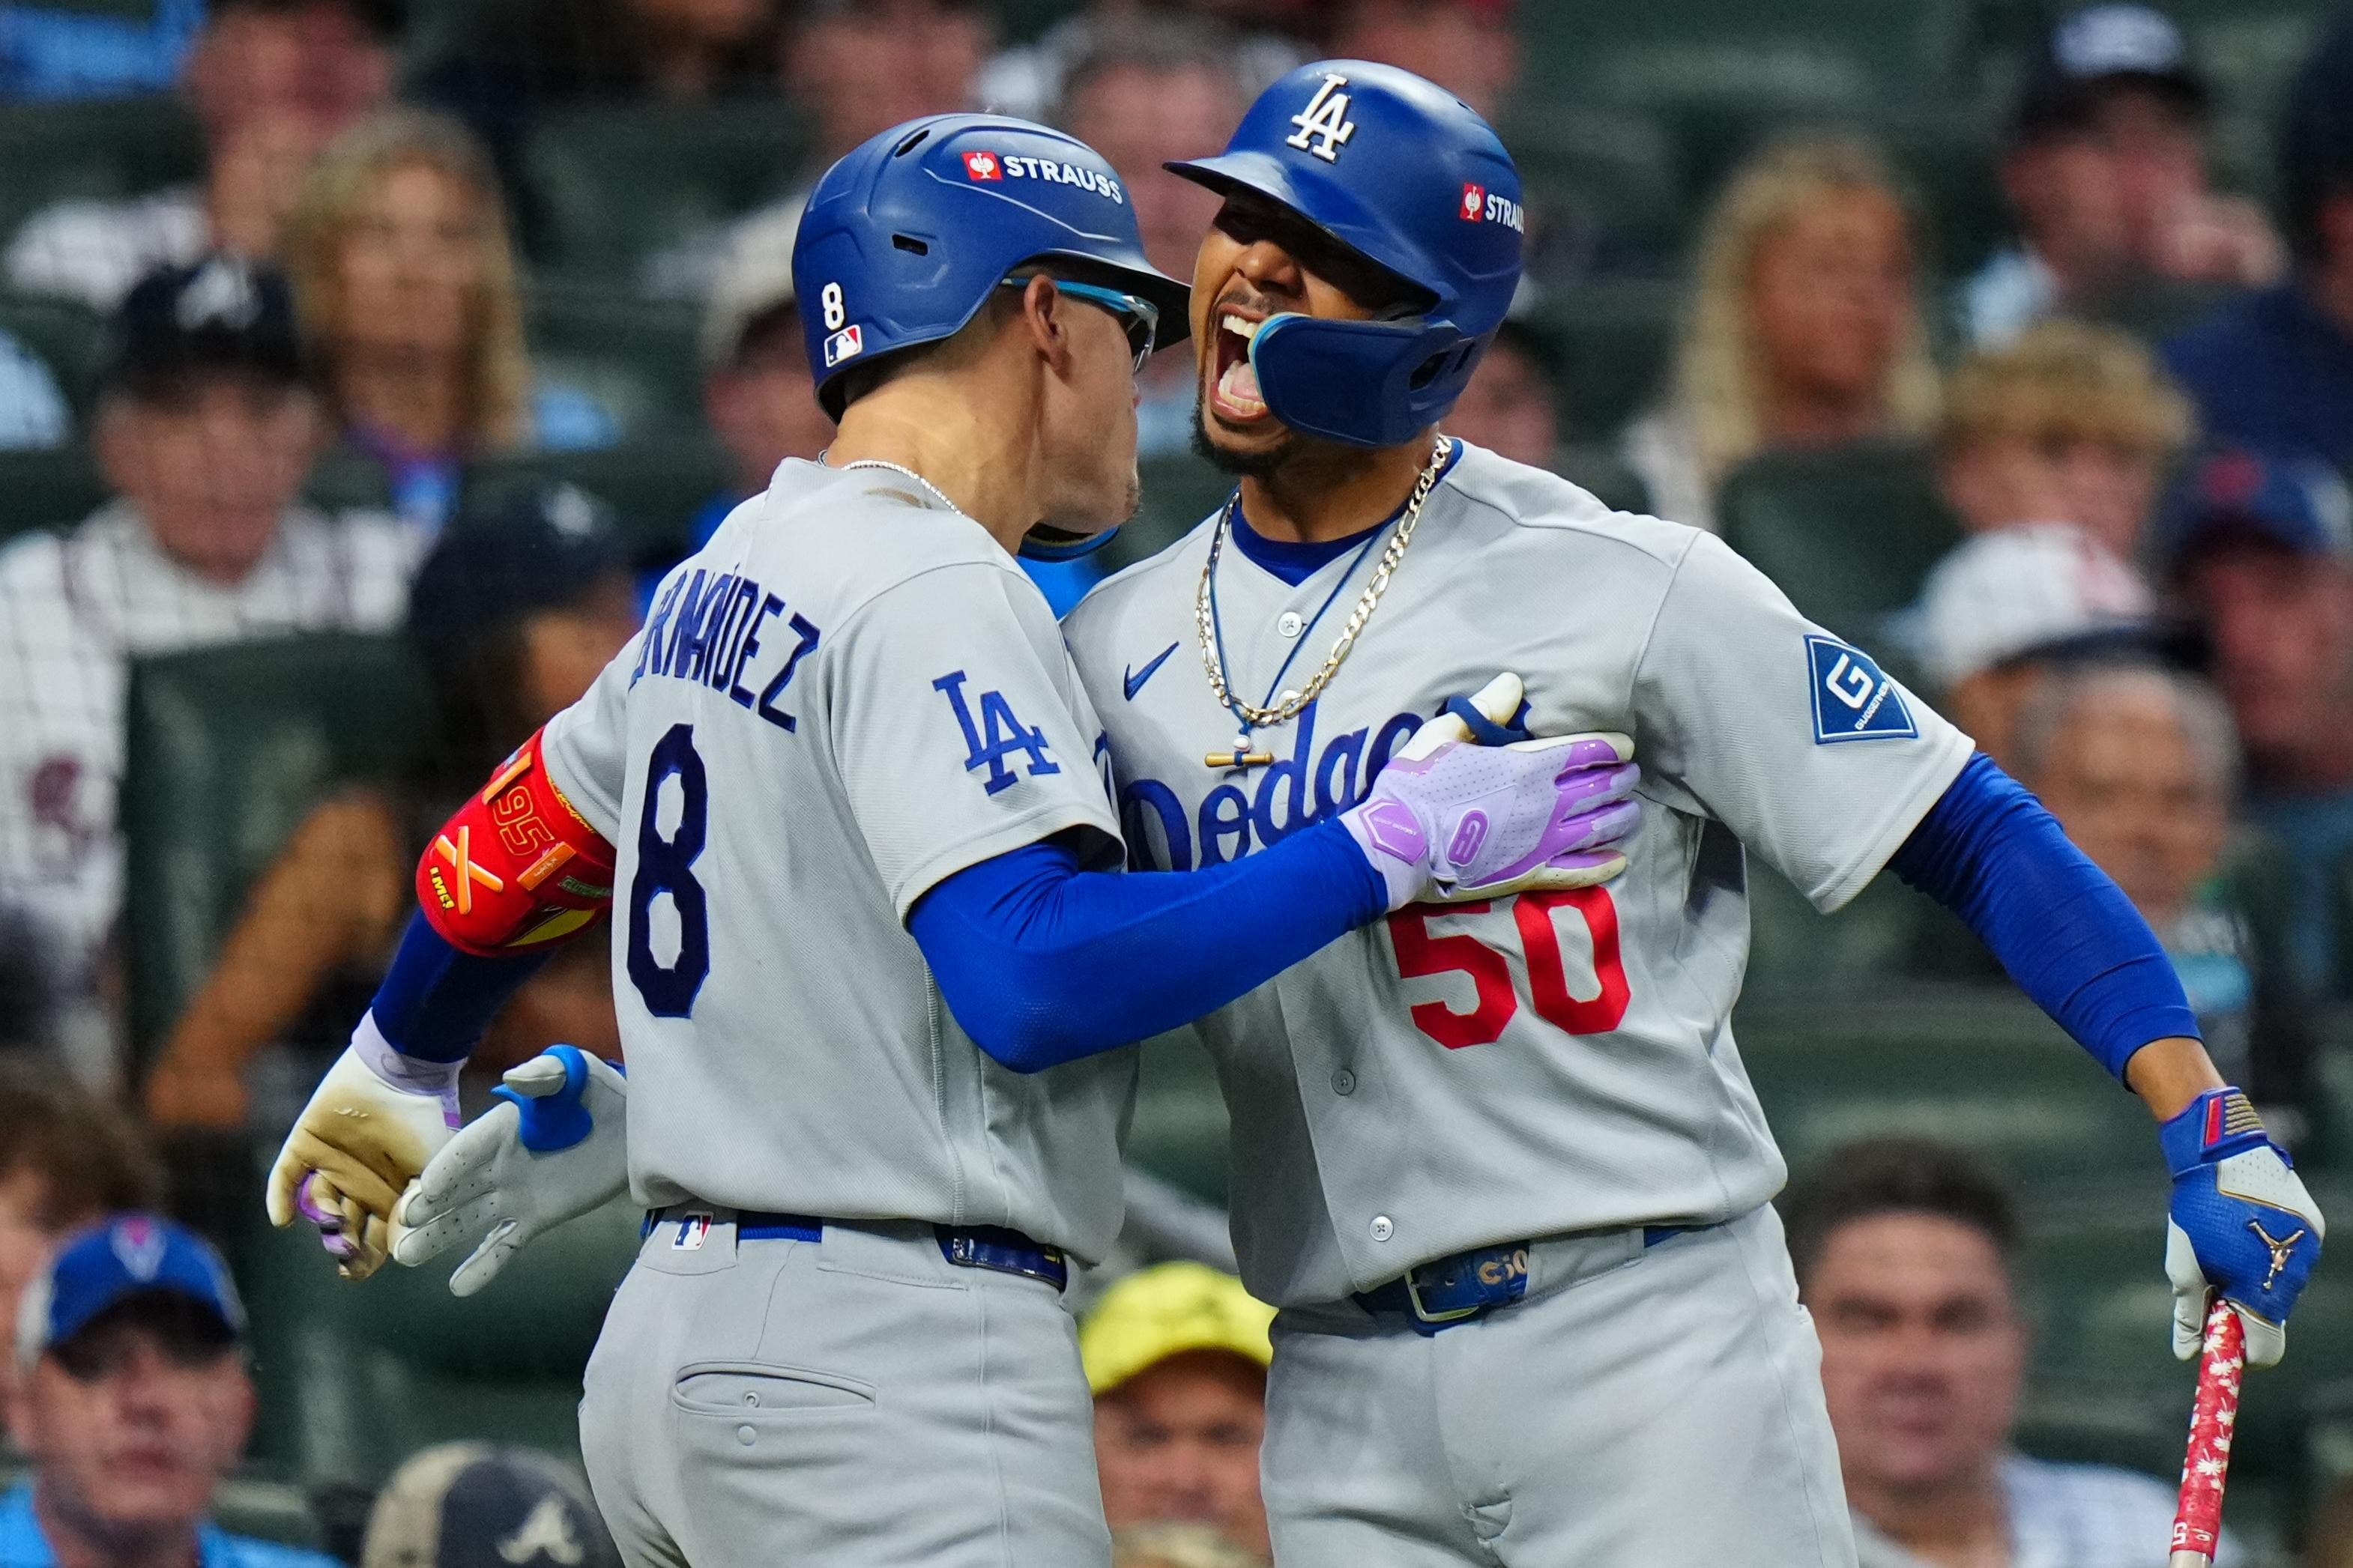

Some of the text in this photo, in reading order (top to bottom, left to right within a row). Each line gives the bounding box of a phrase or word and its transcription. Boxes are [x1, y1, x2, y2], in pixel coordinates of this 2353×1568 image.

[1287, 73, 1355, 161] LA
[1003, 156, 1123, 205] STRAUSS
[1485, 193, 1524, 234] STRAU
[821, 282, 845, 330] 8
[931, 669, 1061, 796] LA
[492, 786, 555, 856] 95
[626, 723, 710, 1019] 8
[1386, 885, 1631, 1050] 50
